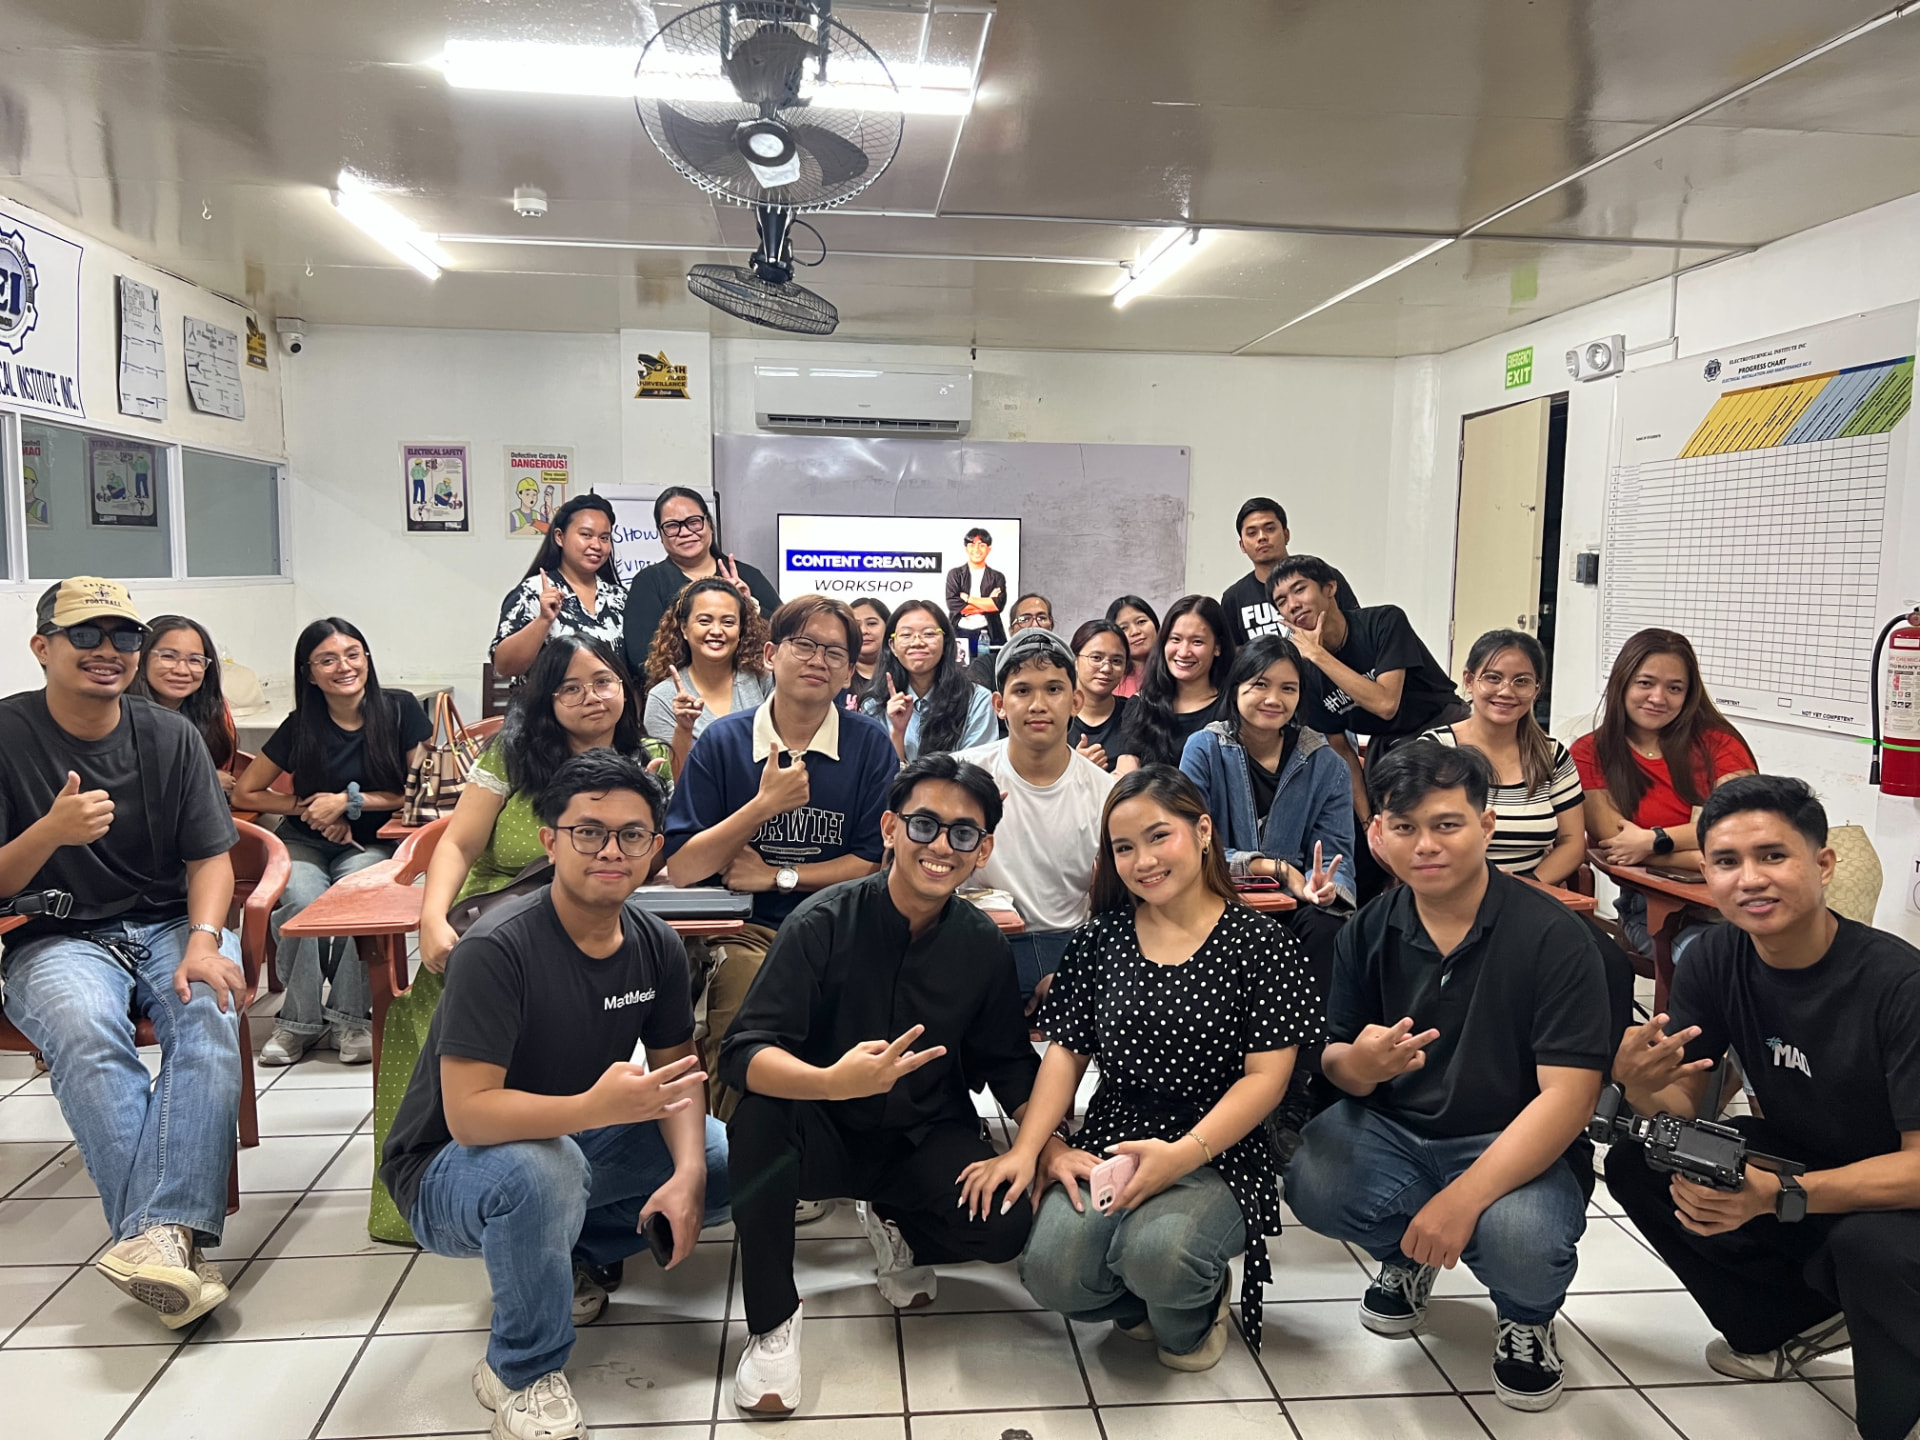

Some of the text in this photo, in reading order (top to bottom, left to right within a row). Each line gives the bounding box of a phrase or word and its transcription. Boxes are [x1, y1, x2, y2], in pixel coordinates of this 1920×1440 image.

[1738, 358, 1787, 374] PROGRESS CHART
[1506, 366, 1531, 387] EXIT
[16, 365, 61, 407] INSTITUTE
[408, 448, 463, 456] ELECTRICAL SAFETY
[511, 459, 567, 469] DANGEROUS!
[791, 554, 937, 569] CONTENT CREATION
[814, 579, 913, 592] WORKSHOP
[1715, 698, 1740, 706] COMPETENT
[1822, 713, 1855, 723] COMPETENT
